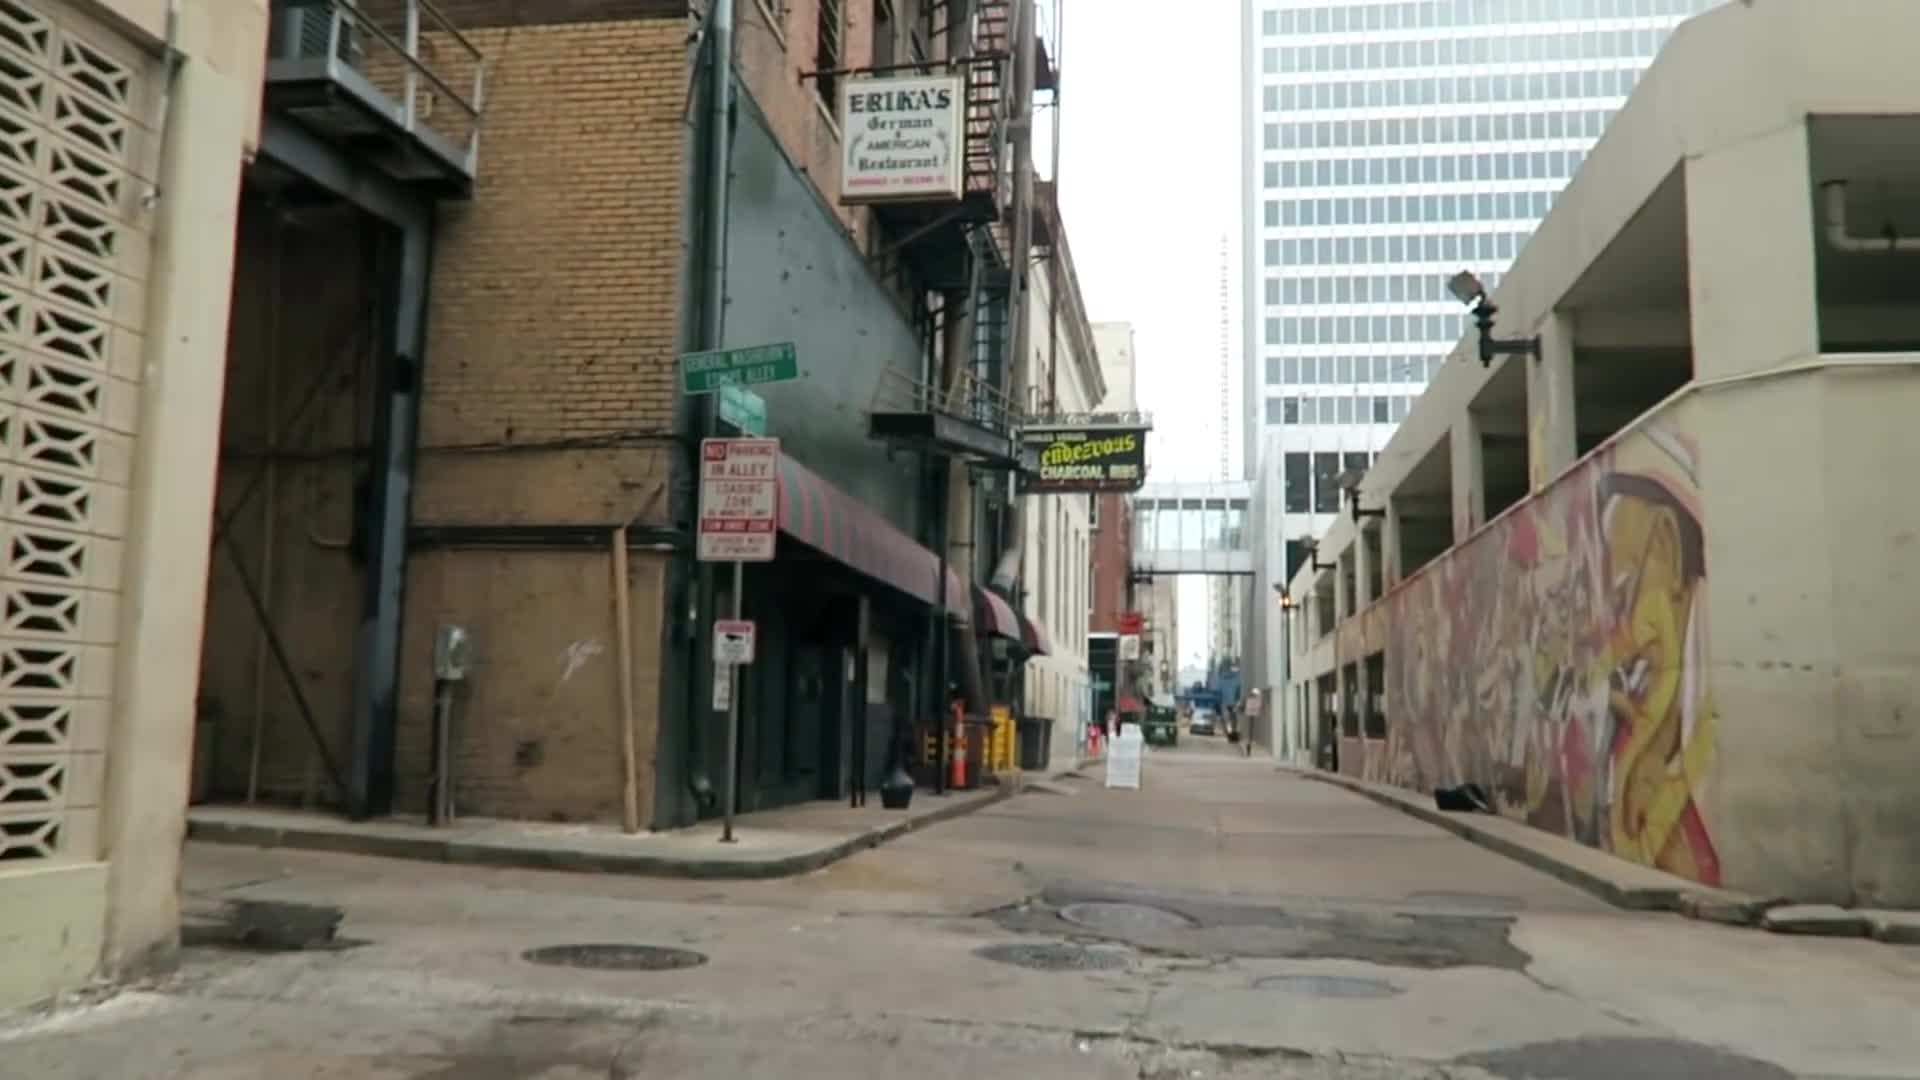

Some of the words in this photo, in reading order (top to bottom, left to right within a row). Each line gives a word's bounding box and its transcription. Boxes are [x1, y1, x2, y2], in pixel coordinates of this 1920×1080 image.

[848, 87, 951, 113] ERIKA'S
[867, 116, 934, 131] German
[867, 139, 931, 151] AMERICAN
[858, 156, 939, 171] Restaurant
[729, 464, 768, 476] ALLEY
[1040, 465, 1106, 480] CHARCOAL
